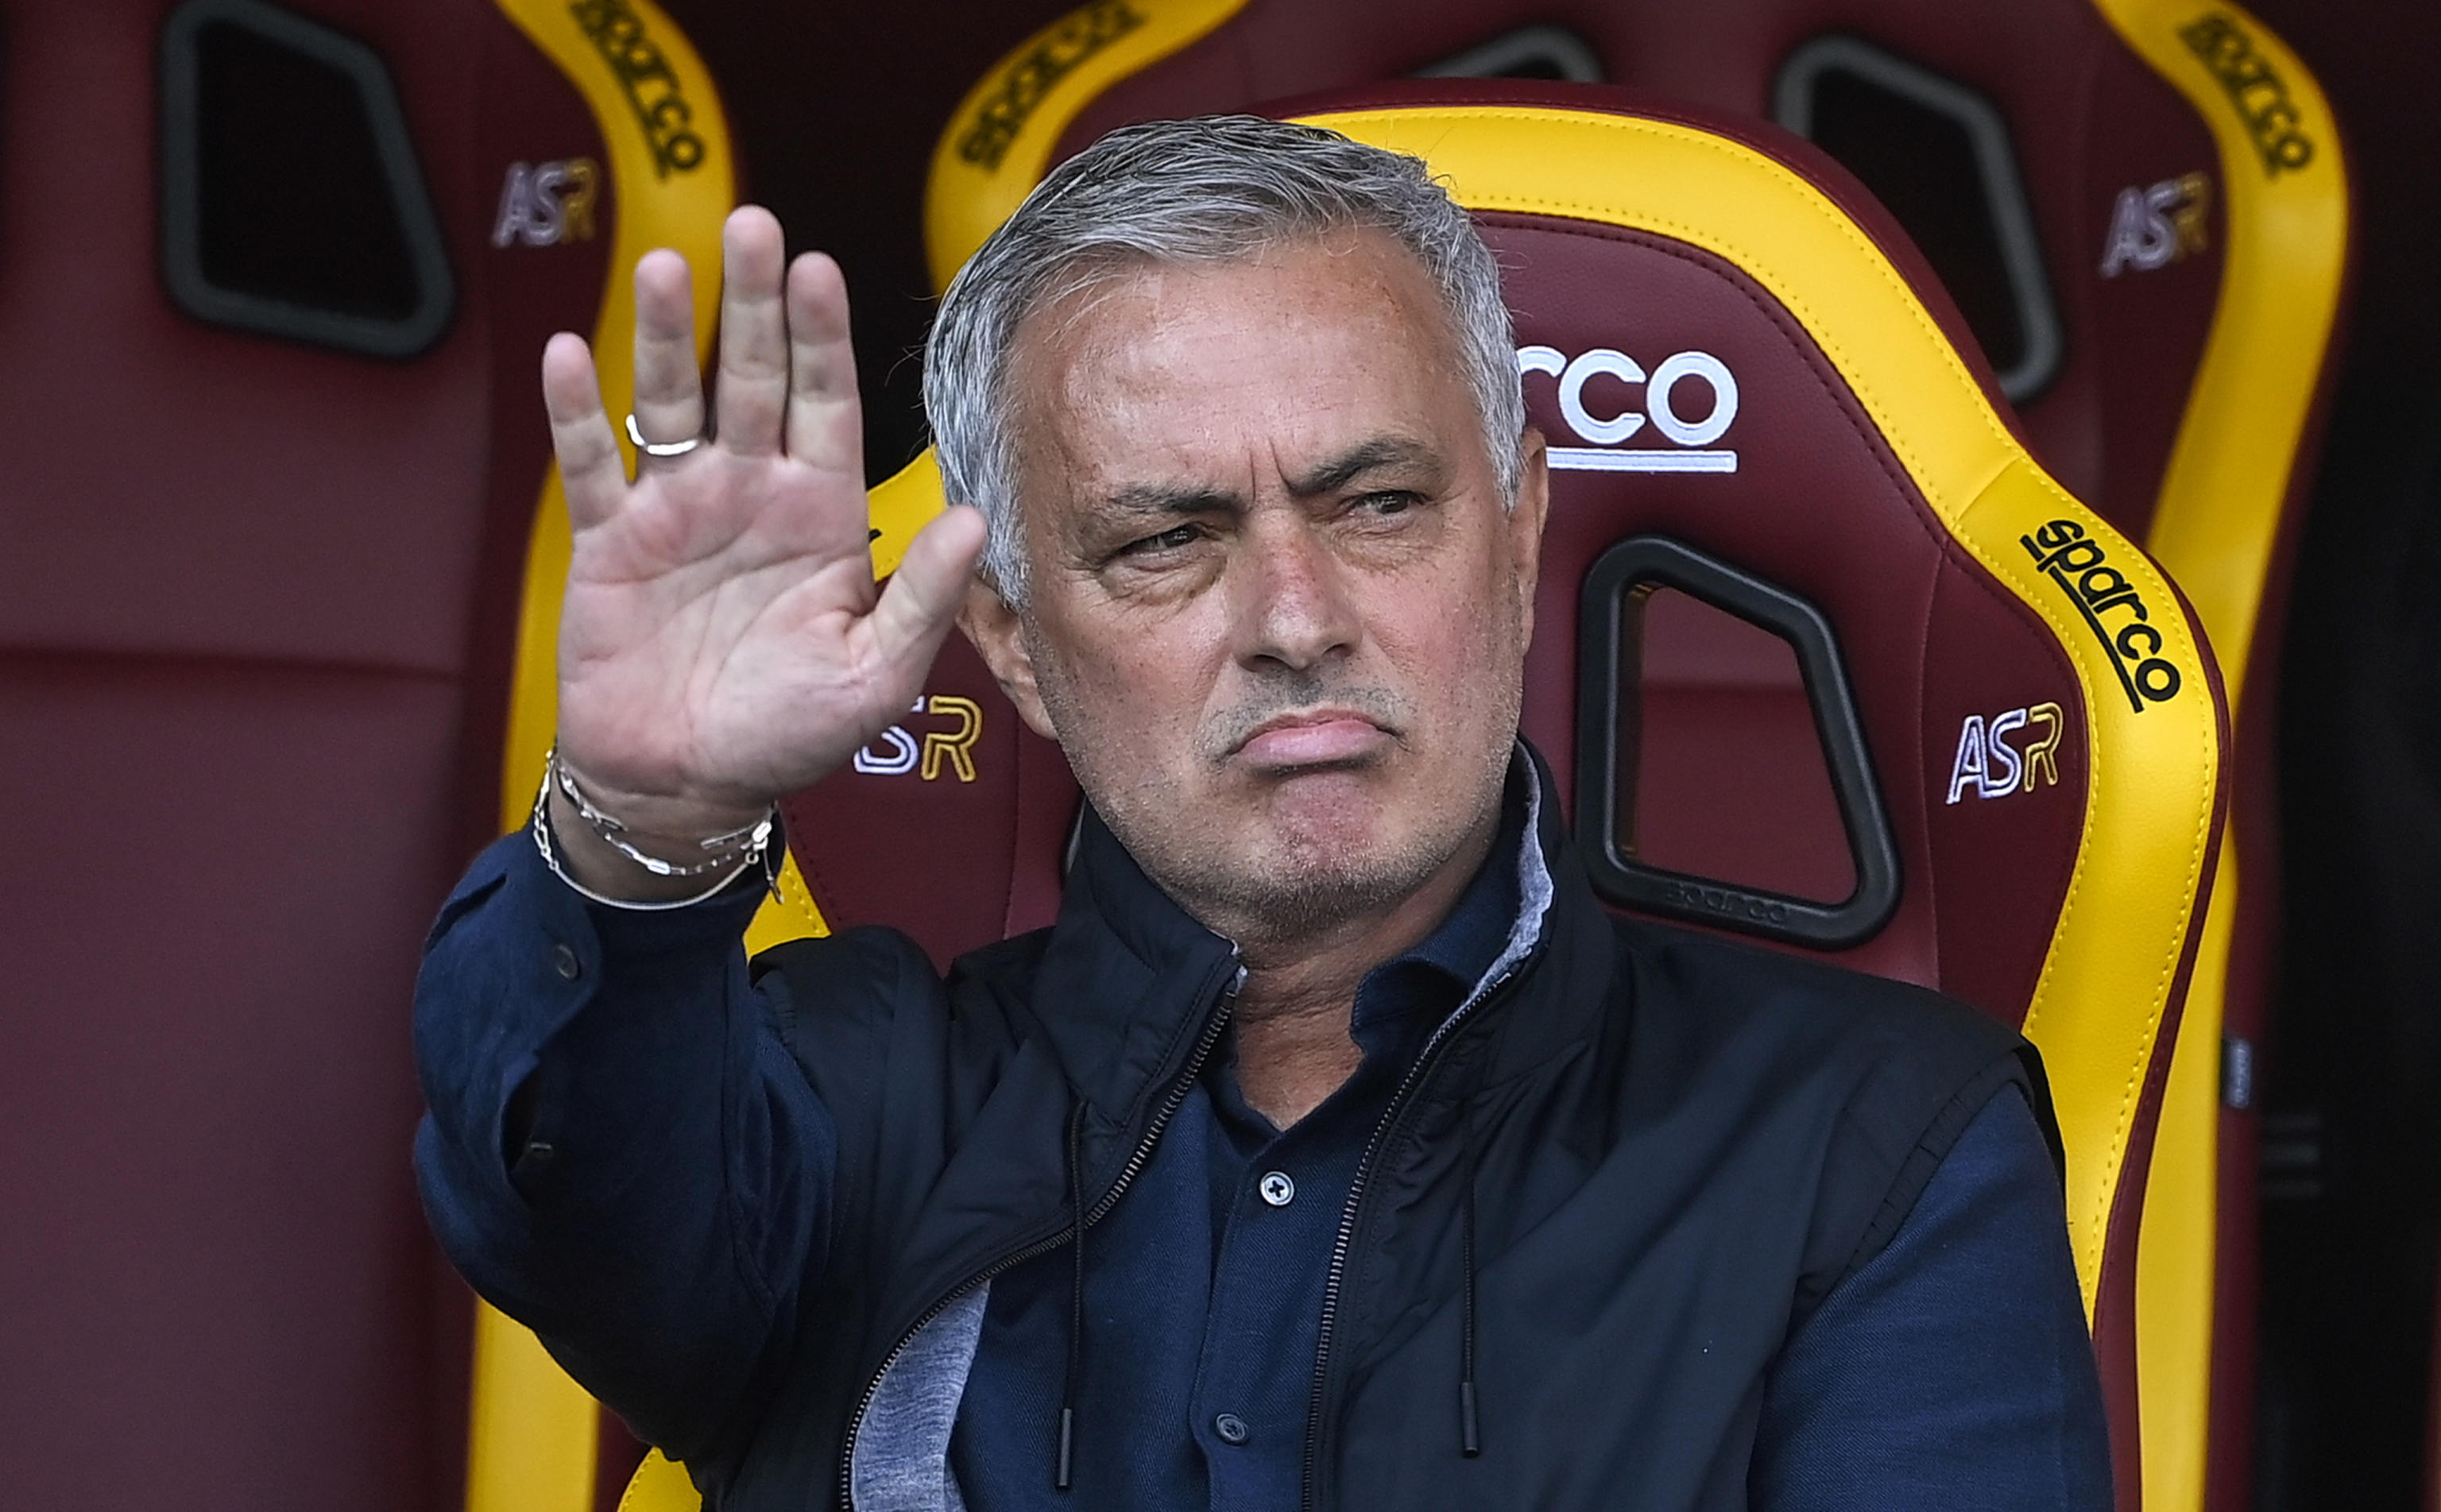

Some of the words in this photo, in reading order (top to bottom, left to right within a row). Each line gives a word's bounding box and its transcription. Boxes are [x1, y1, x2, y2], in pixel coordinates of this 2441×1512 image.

[569, 0, 707, 181] sparco
[2177, 14, 2314, 181] sparco
[489, 159, 598, 249] ASR
[2099, 170, 2211, 278] ASR
[2033, 519, 2182, 704] sparco
[853, 695, 983, 783] SR
[1946, 702, 2064, 805] ASR
[1666, 882, 1789, 926] sparco
